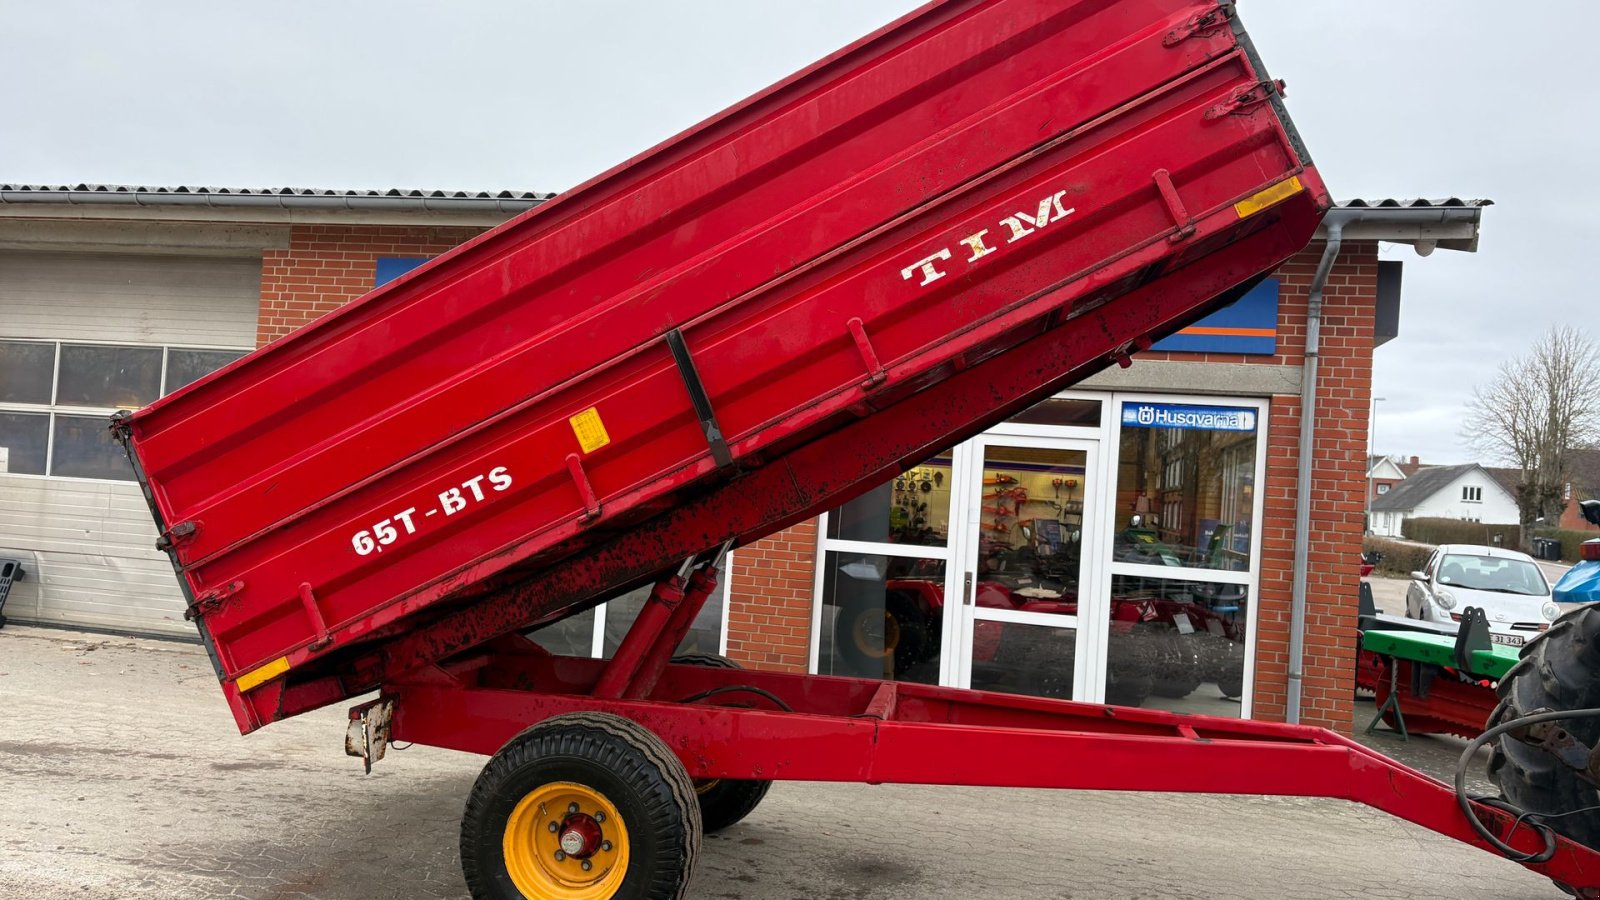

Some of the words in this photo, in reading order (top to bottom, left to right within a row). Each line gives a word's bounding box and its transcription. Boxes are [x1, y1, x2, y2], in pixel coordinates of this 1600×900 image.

[901, 190, 1075, 286] TIM
[1156, 409, 1239, 427] Husqvarna
[1495, 635, 1504, 643] 31
[1506, 636, 1522, 645] 343
